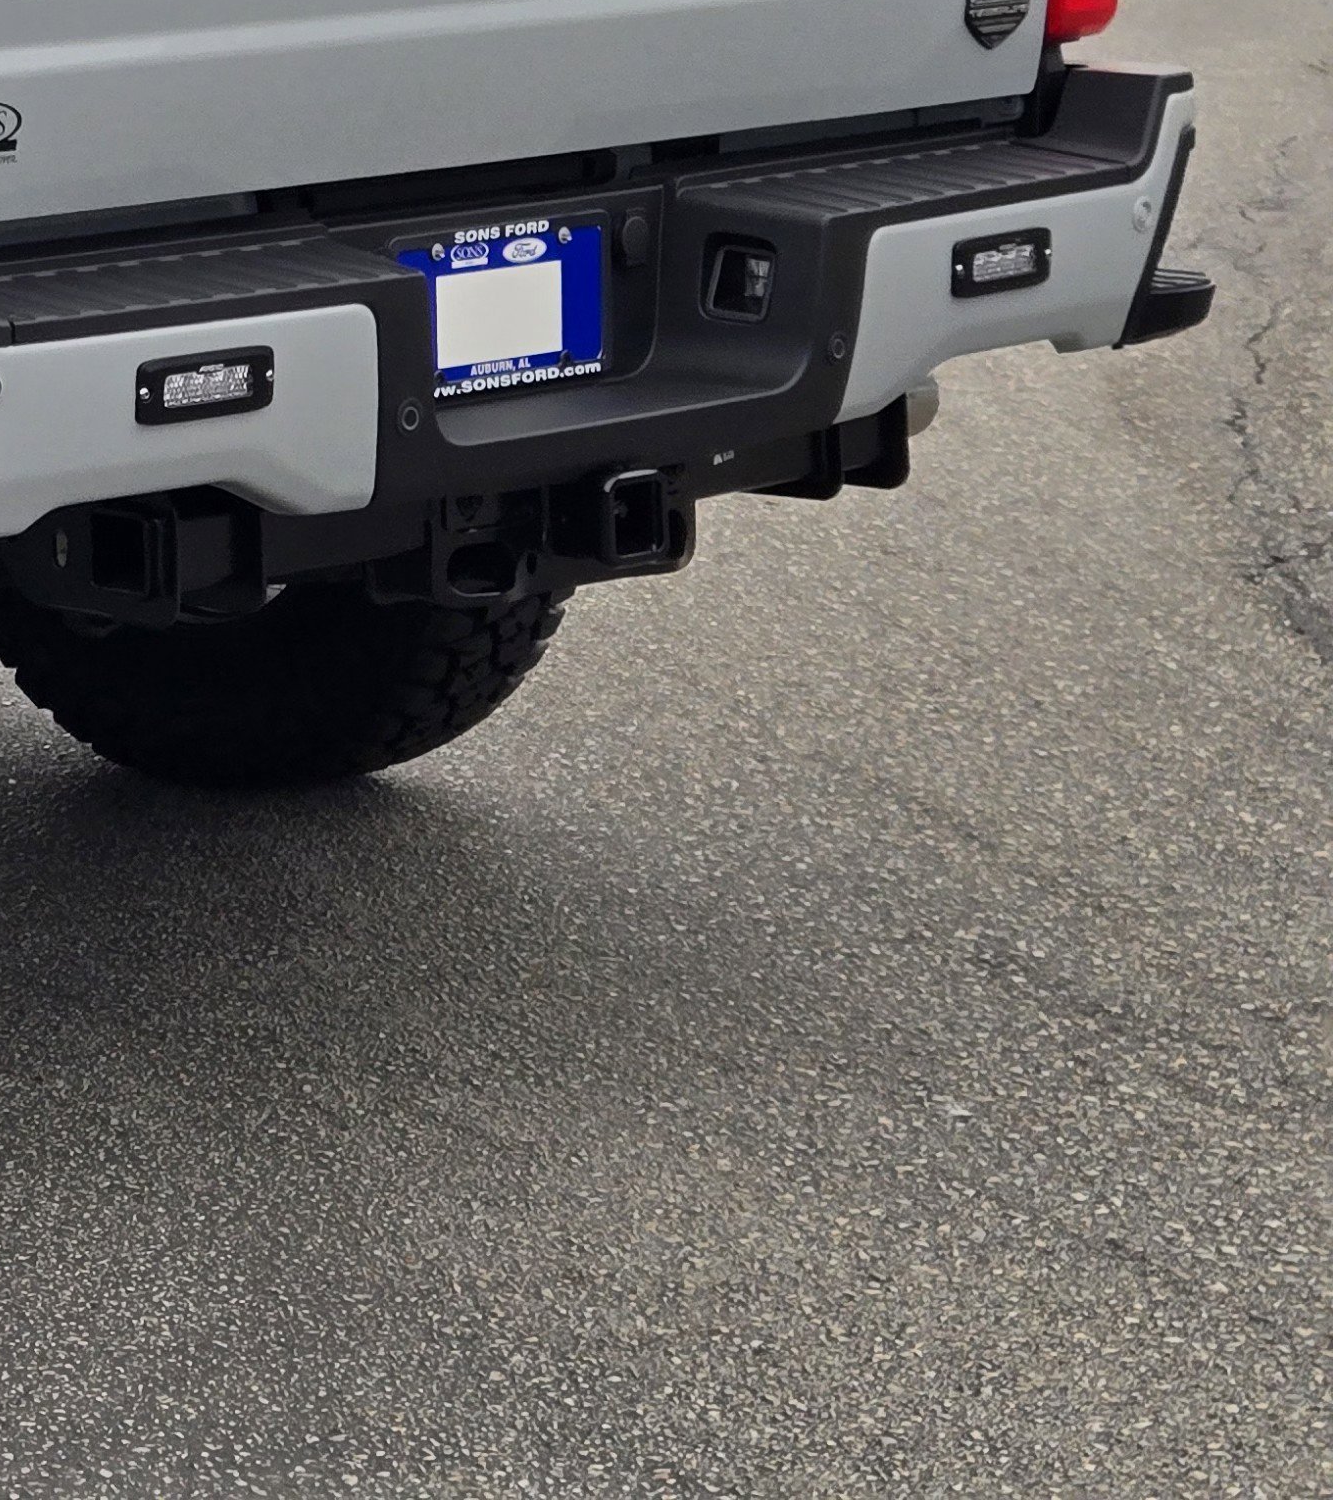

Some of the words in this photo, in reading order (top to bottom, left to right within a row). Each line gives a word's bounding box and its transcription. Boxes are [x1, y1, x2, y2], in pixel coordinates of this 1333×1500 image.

[454, 226, 501, 244] SONS
[504, 219, 550, 238] FORD
[470, 359, 516, 377] AUBURN,
[517, 357, 531, 370] AL
